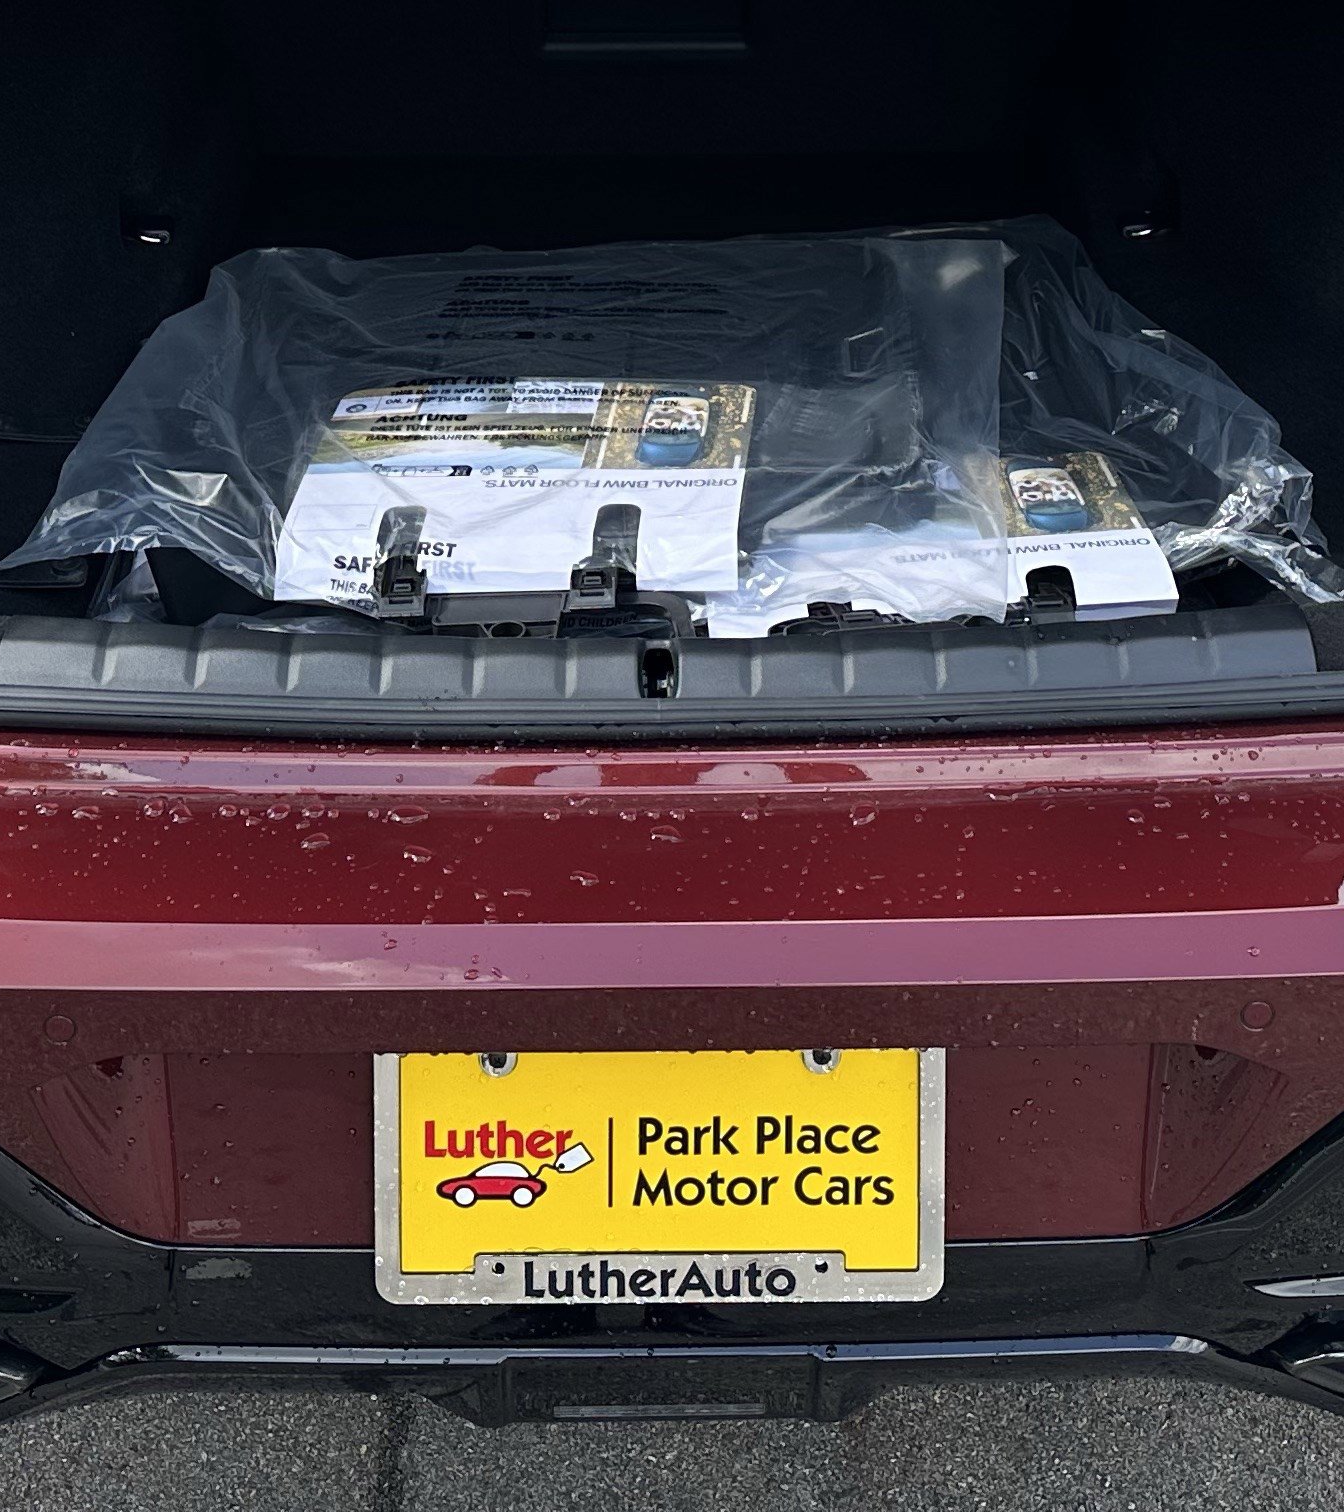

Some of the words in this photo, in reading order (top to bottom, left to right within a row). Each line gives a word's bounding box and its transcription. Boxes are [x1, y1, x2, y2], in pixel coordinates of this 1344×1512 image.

[454, 387, 475, 395] NOT
[374, 413, 469, 424] ACHTUNG
[540, 478, 601, 488] FLOOR
[602, 479, 649, 489] BMW
[652, 478, 738, 488] ORIGINAL
[1015, 543, 1062, 555] BMW
[1063, 537, 1152, 550] ORIGINAL
[424, 1120, 573, 1159] Luther
[637, 1116, 739, 1157] Park
[756, 1115, 881, 1155] Place
[632, 1167, 778, 1207] Motor
[794, 1166, 895, 1206] Cars
[524, 1260, 796, 1299] LutherAuto
